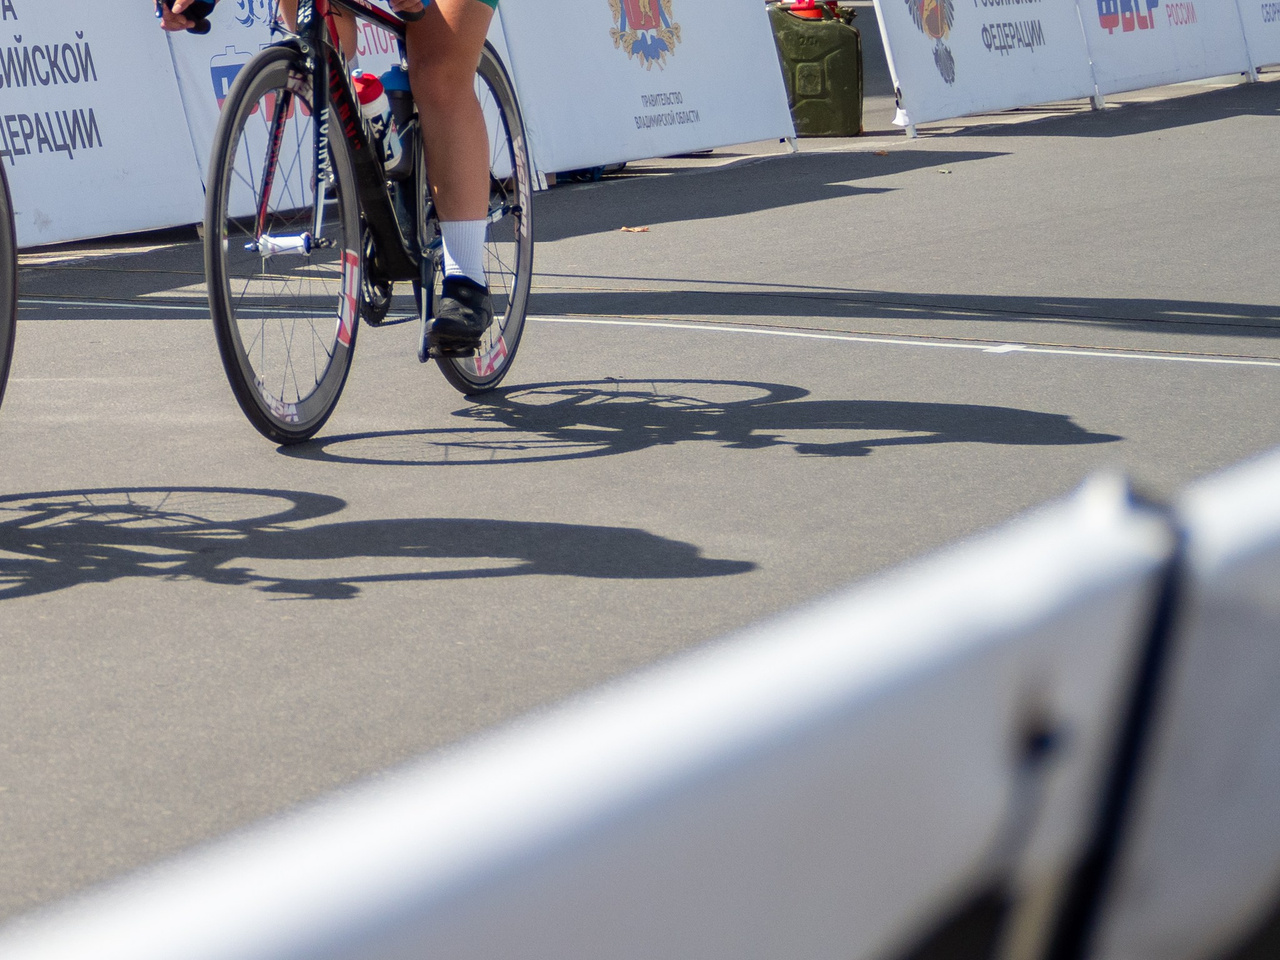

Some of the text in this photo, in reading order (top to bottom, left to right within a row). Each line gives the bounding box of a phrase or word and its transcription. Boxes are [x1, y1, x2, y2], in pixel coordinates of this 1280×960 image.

[1165, 1, 1198, 27] РОССИИ
[356, 21, 397, 57] СПОР
[981, 19, 1046, 57] ФЕДЕРАЦИИ
[641, 91, 684, 108] ПРАВИТЕЛЬСТВО
[634, 110, 701, 130] ВЛАДИМИРСКОЙ ОБЛАСТИ
[317, 107, 330, 180] CANYON
